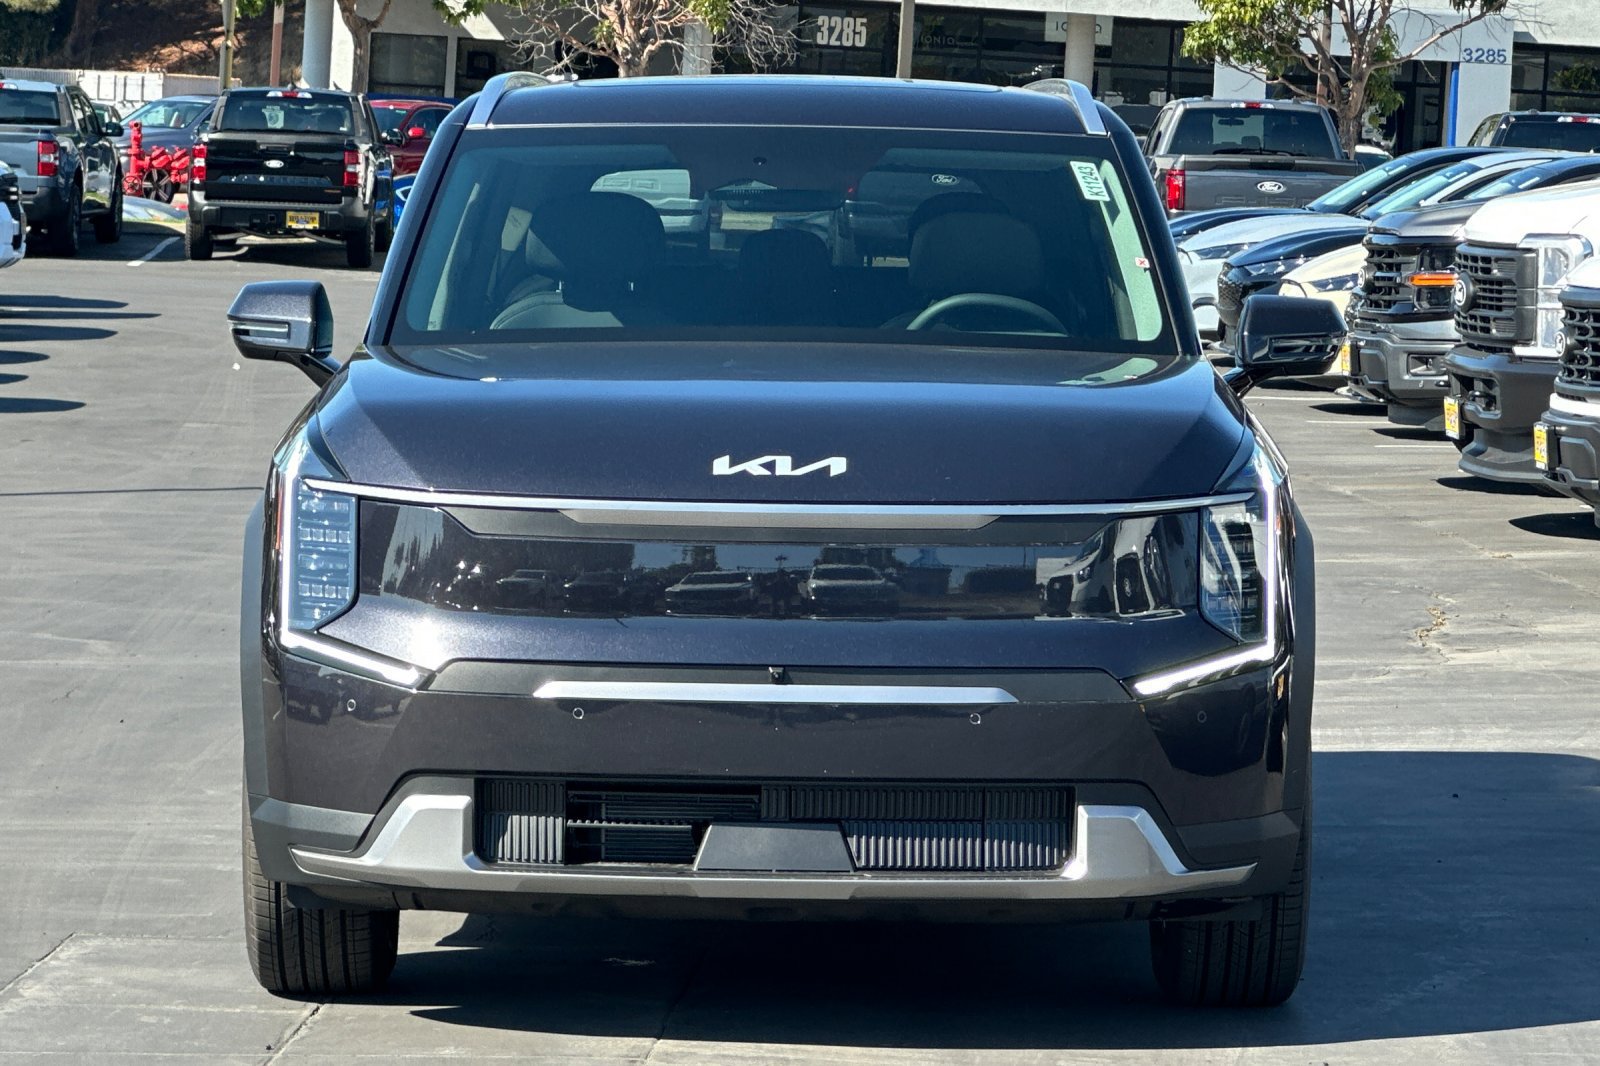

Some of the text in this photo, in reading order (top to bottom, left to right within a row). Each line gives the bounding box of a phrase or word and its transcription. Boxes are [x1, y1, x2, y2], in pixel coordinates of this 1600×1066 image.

[816, 15, 868, 47] 3285
[1056, 21, 1102, 34] IOQ
[1462, 47, 1507, 64] 3285
[1078, 165, 1106, 197] K11243
[713, 455, 847, 477] KIA
